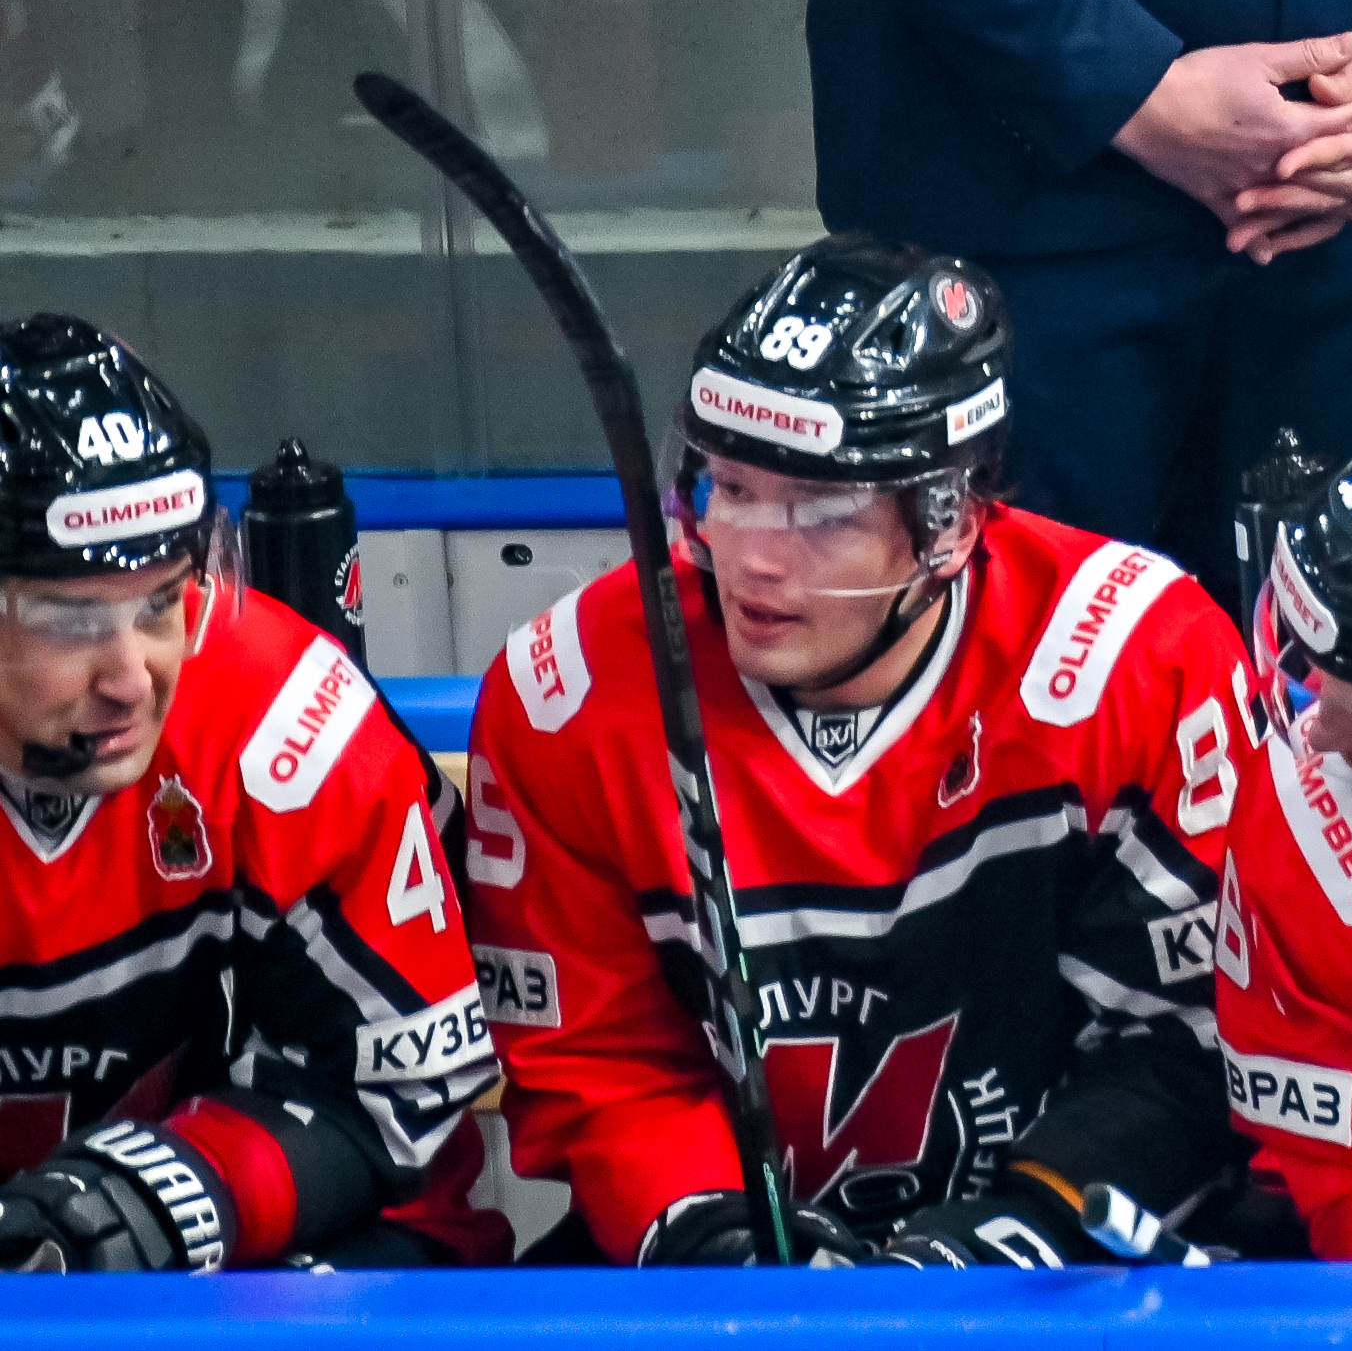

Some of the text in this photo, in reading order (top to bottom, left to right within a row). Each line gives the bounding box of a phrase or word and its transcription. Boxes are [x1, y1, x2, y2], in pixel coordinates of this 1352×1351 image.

[759, 315, 833, 371] 89
[76, 412, 148, 466] 40
[698, 386, 828, 438] OLIMPBET
[63, 486, 197, 530] OLIMPBET
[1048, 550, 1157, 701] OLIMPBET
[385, 800, 447, 934] 4
